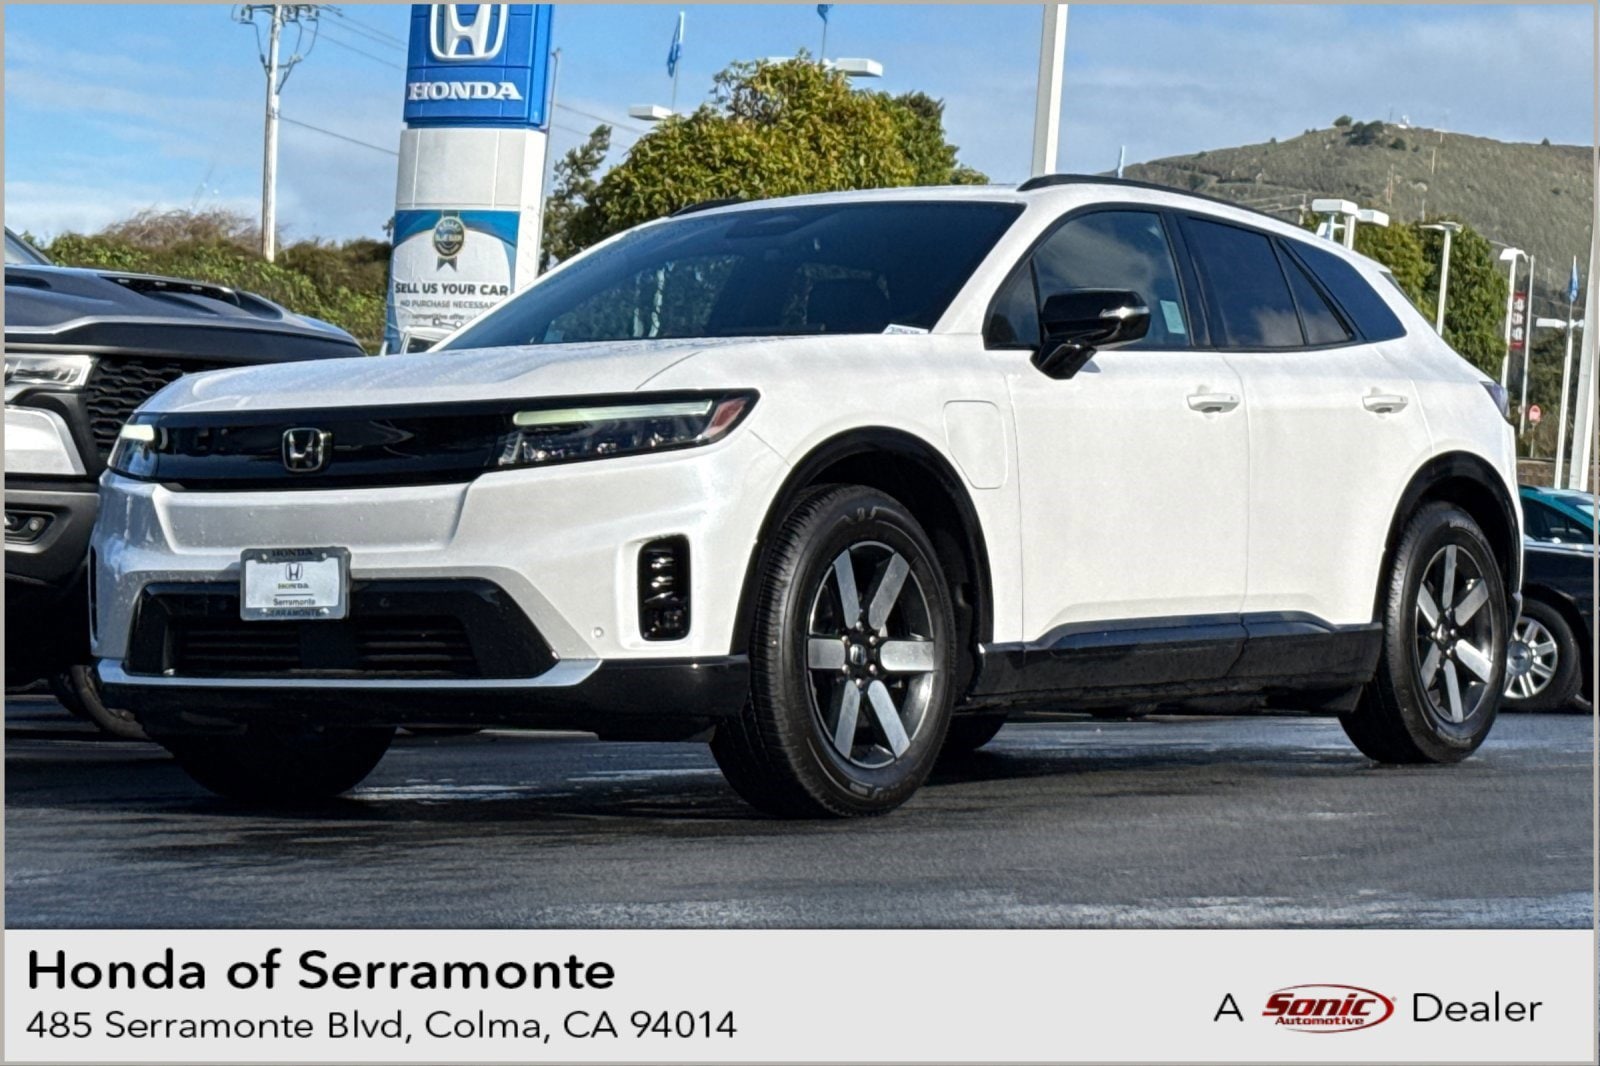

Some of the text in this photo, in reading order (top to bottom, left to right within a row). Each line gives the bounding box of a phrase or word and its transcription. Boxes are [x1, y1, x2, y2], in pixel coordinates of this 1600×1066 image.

[408, 81, 523, 101] HONDA
[395, 283, 508, 296] SELL US YOUR CAR
[453, 301, 498, 309] NECESSAR
[272, 549, 313, 557] HONDA
